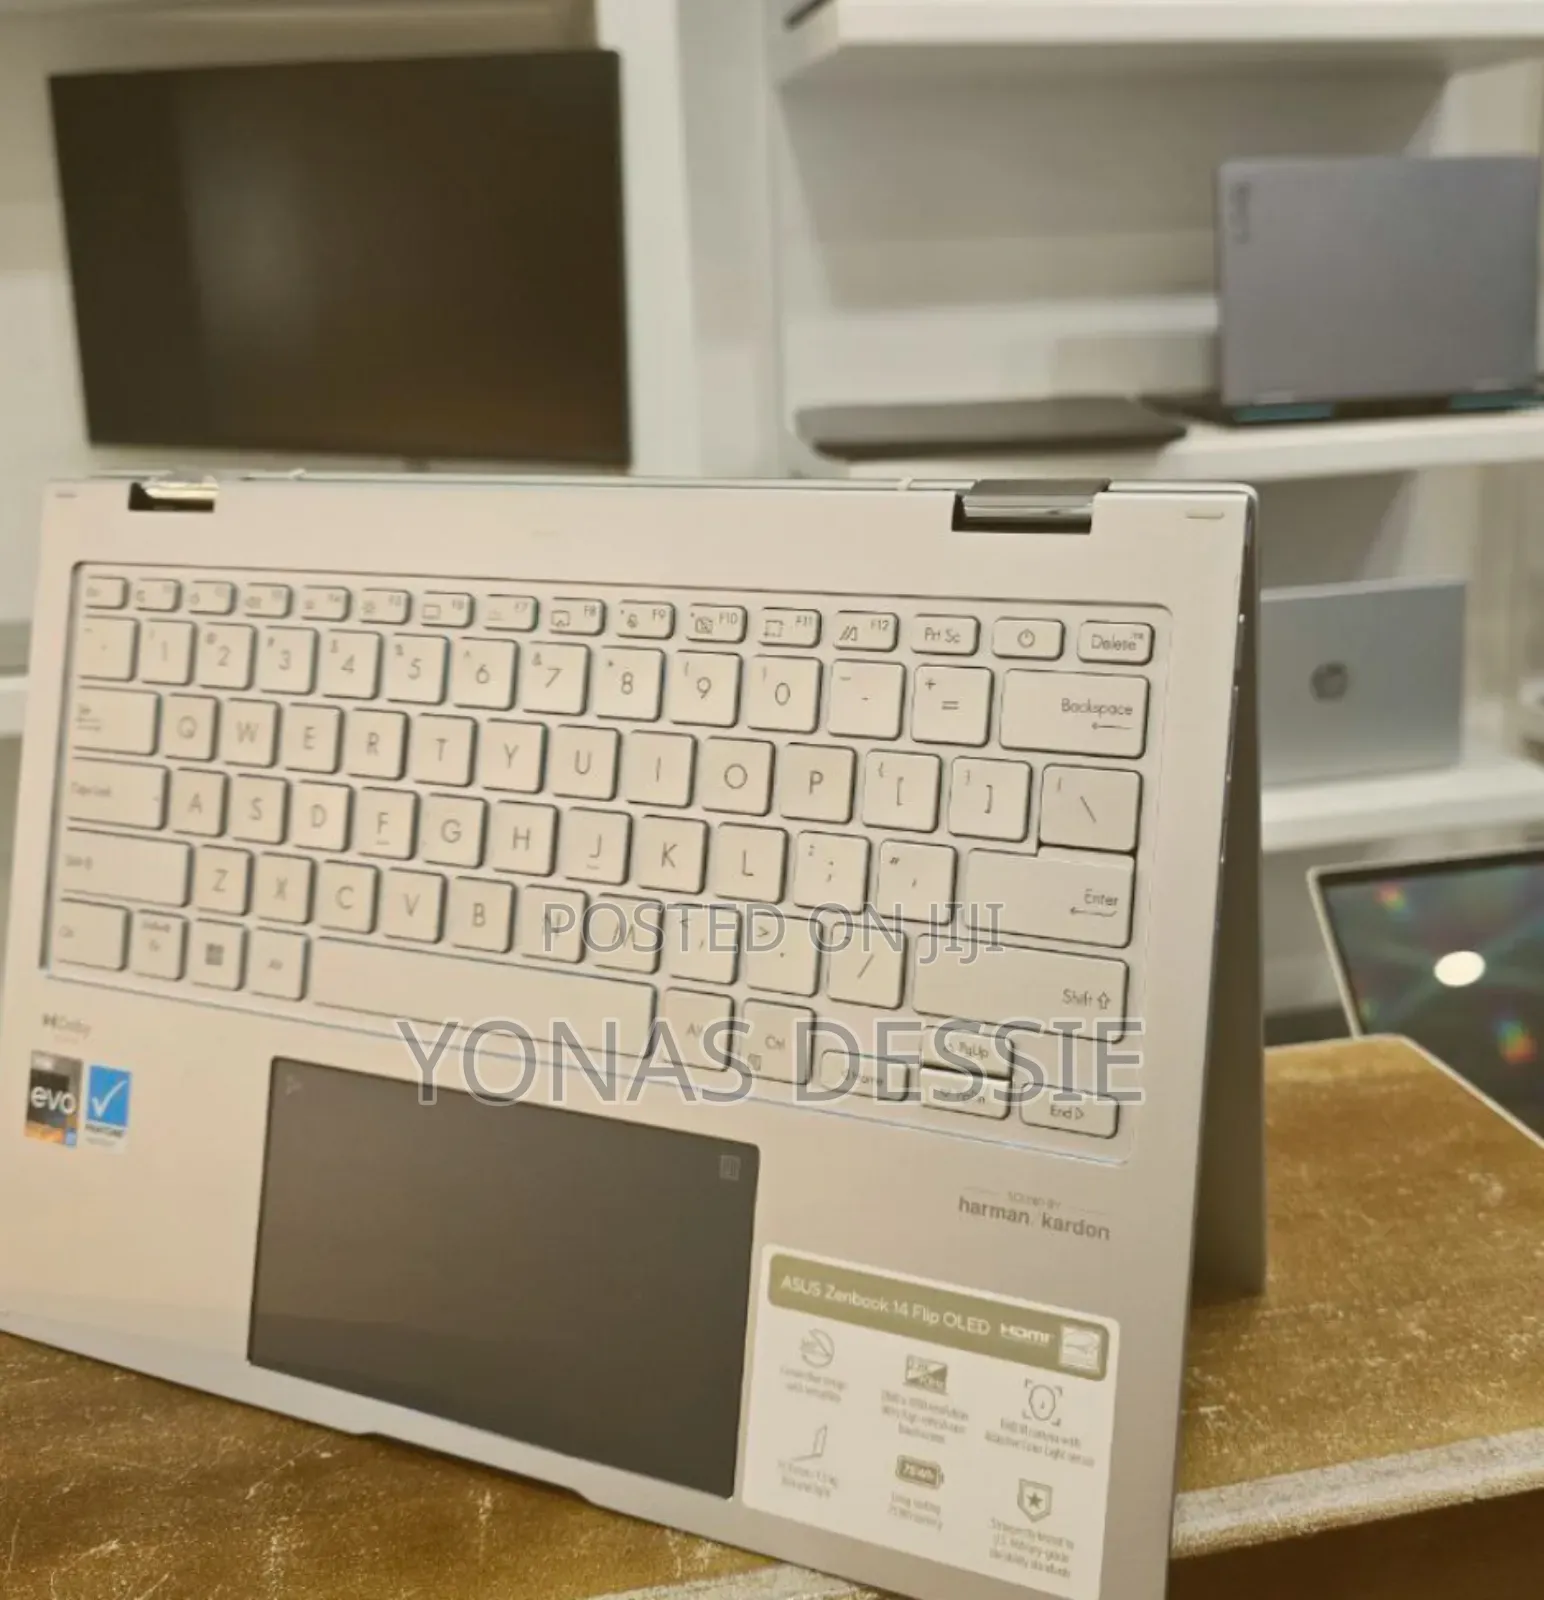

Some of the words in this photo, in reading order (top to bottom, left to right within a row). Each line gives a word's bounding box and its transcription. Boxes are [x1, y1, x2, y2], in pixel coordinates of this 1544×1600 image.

[583, 605, 597, 618] F8
[652, 608, 666, 621] F9
[719, 613, 738, 626] F10
[795, 616, 814, 628] F11
[870, 619, 889, 631] F12
[217, 644, 231, 667] 2
[278, 649, 291, 671] 3
[341, 653, 355, 674] 4
[407, 657, 422, 680] 5
[475, 663, 490, 684] 6
[545, 668, 562, 688] 7
[621, 671, 634, 695] 8
[697, 677, 712, 699] 9
[1061, 698, 1134, 719] Backspace
[177, 715, 197, 740] Q
[236, 720, 259, 744] W
[303, 725, 316, 751] E
[366, 732, 380, 756] R
[436, 738, 449, 762] T
[503, 743, 519, 769] Y
[574, 749, 592, 775] U
[723, 763, 748, 789] O
[808, 769, 824, 794] P
[188, 793, 203, 814] A
[249, 797, 263, 821] S
[310, 804, 327, 829] D
[377, 811, 389, 834] F
[441, 819, 462, 843] G
[512, 826, 531, 851] H
[588, 834, 602, 858] J
[661, 842, 678, 868] K
[742, 849, 754, 877] L
[212, 868, 229, 893] Z
[274, 876, 288, 901] X
[335, 886, 355, 910] C
[404, 893, 420, 917] V
[1084, 889, 1118, 906] Enter
[472, 902, 486, 928] B
[1061, 988, 1093, 1006] Shift
[30, 1085, 77, 1115] evo
[1049, 1105, 1073, 1119] End
[780, 1275, 822, 1298] ASUS
[824, 1283, 889, 1314] Zenbook
[893, 1298, 909, 1318] 14
[911, 1303, 941, 1326] Flip
[942, 1311, 991, 1336] OLED
